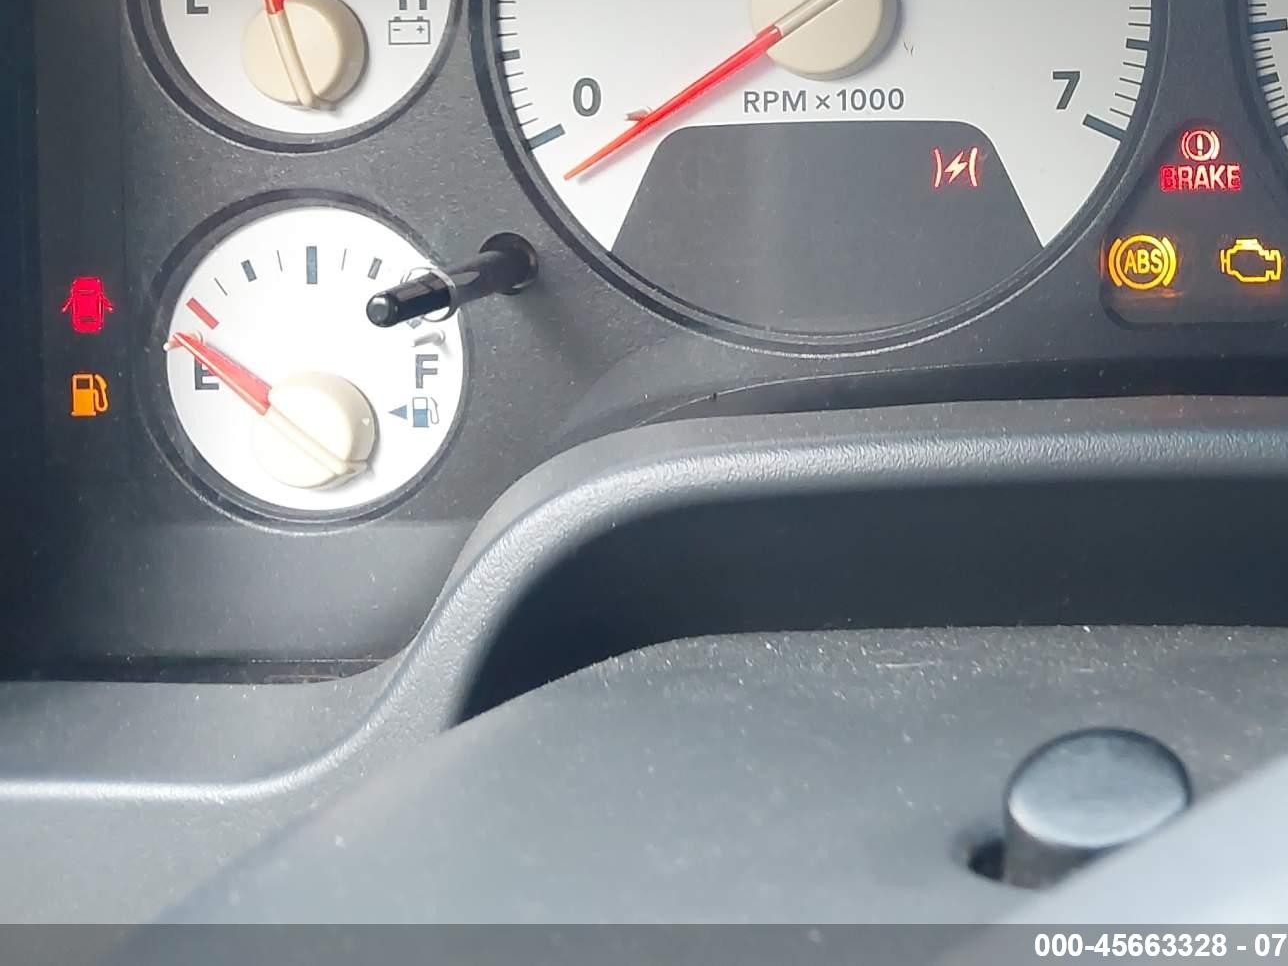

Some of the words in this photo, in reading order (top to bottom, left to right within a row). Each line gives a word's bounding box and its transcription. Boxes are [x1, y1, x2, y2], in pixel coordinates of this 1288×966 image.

[573, 78, 601, 117] 0
[744, 90, 806, 112] RPM
[1053, 71, 1080, 109] 7
[1160, 165, 1240, 191] BRAKE
[1123, 248, 1163, 275] ABS
[416, 354, 438, 389] F
